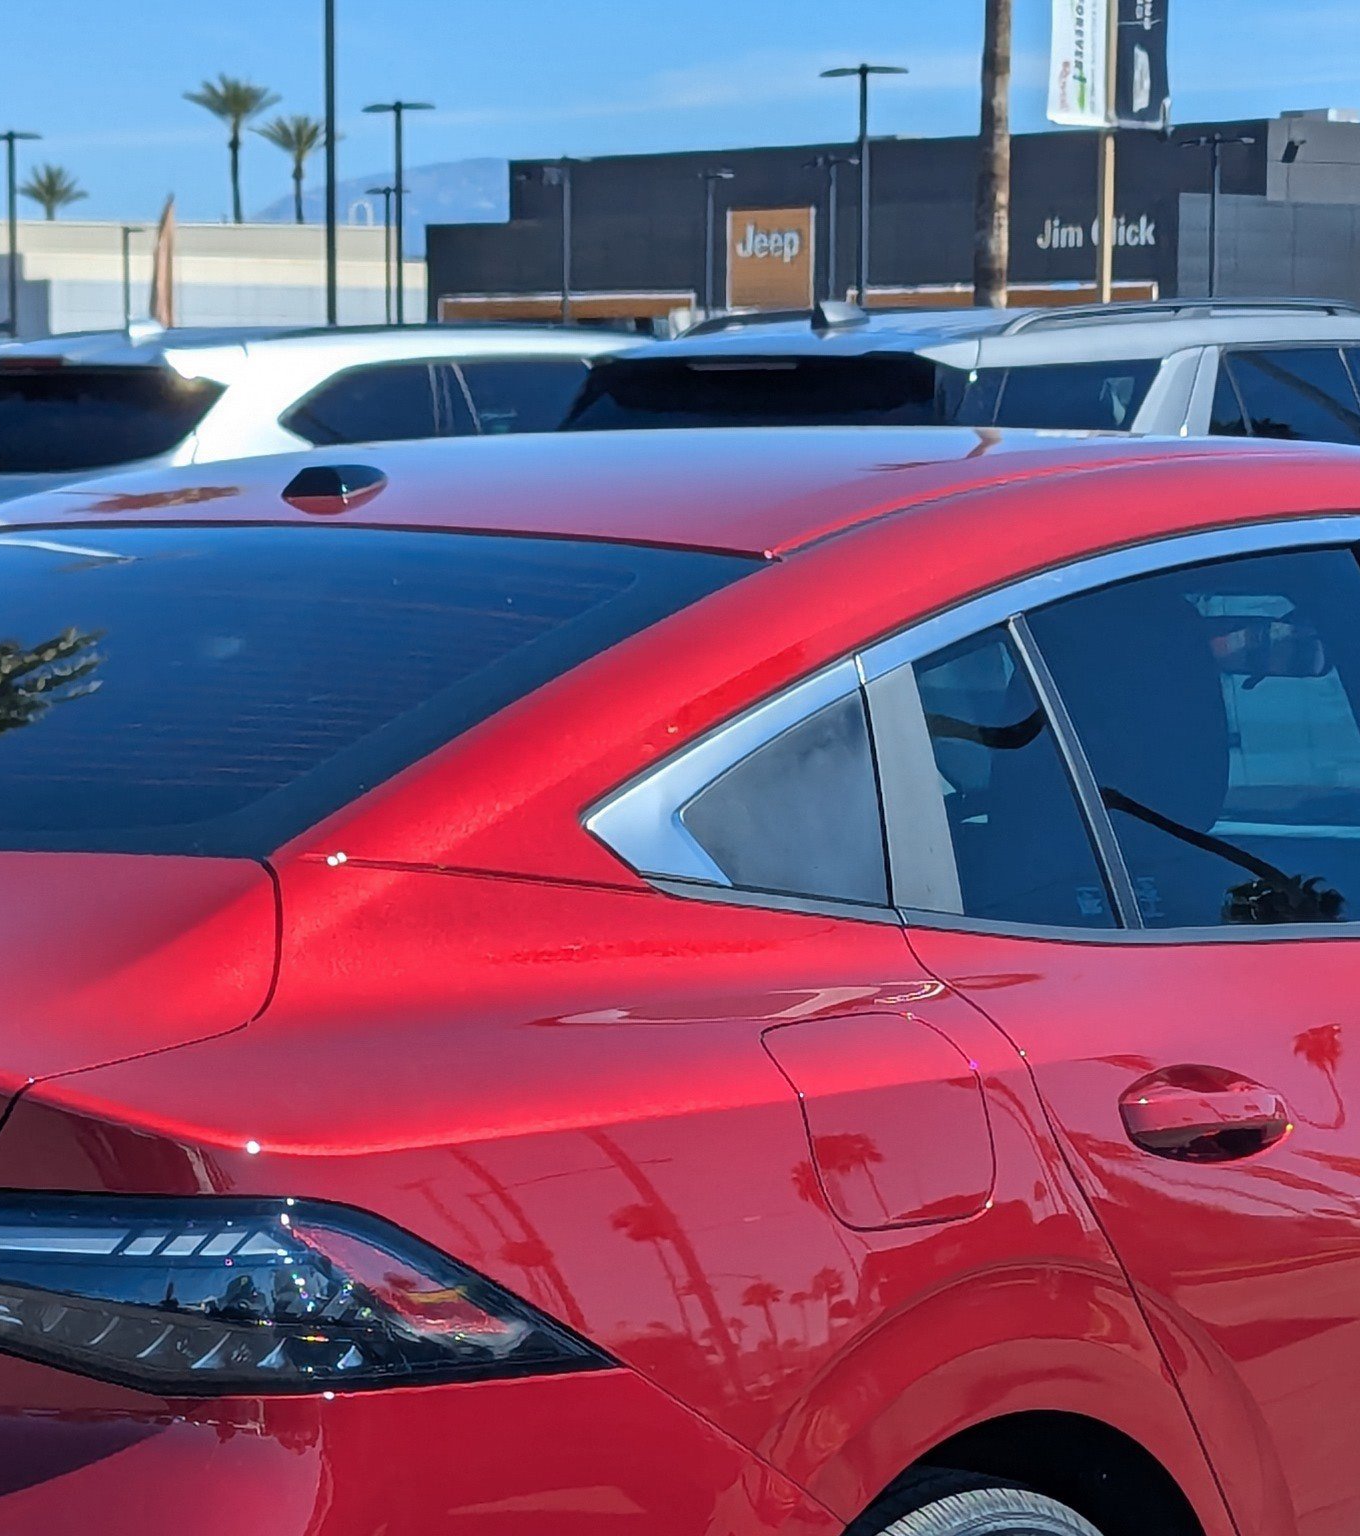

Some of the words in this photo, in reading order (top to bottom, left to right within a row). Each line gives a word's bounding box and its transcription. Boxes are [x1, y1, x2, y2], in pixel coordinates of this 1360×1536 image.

[1073, 0, 1086, 70] OREVER
[735, 223, 800, 263] Jeep
[1036, 217, 1083, 249] Jim
